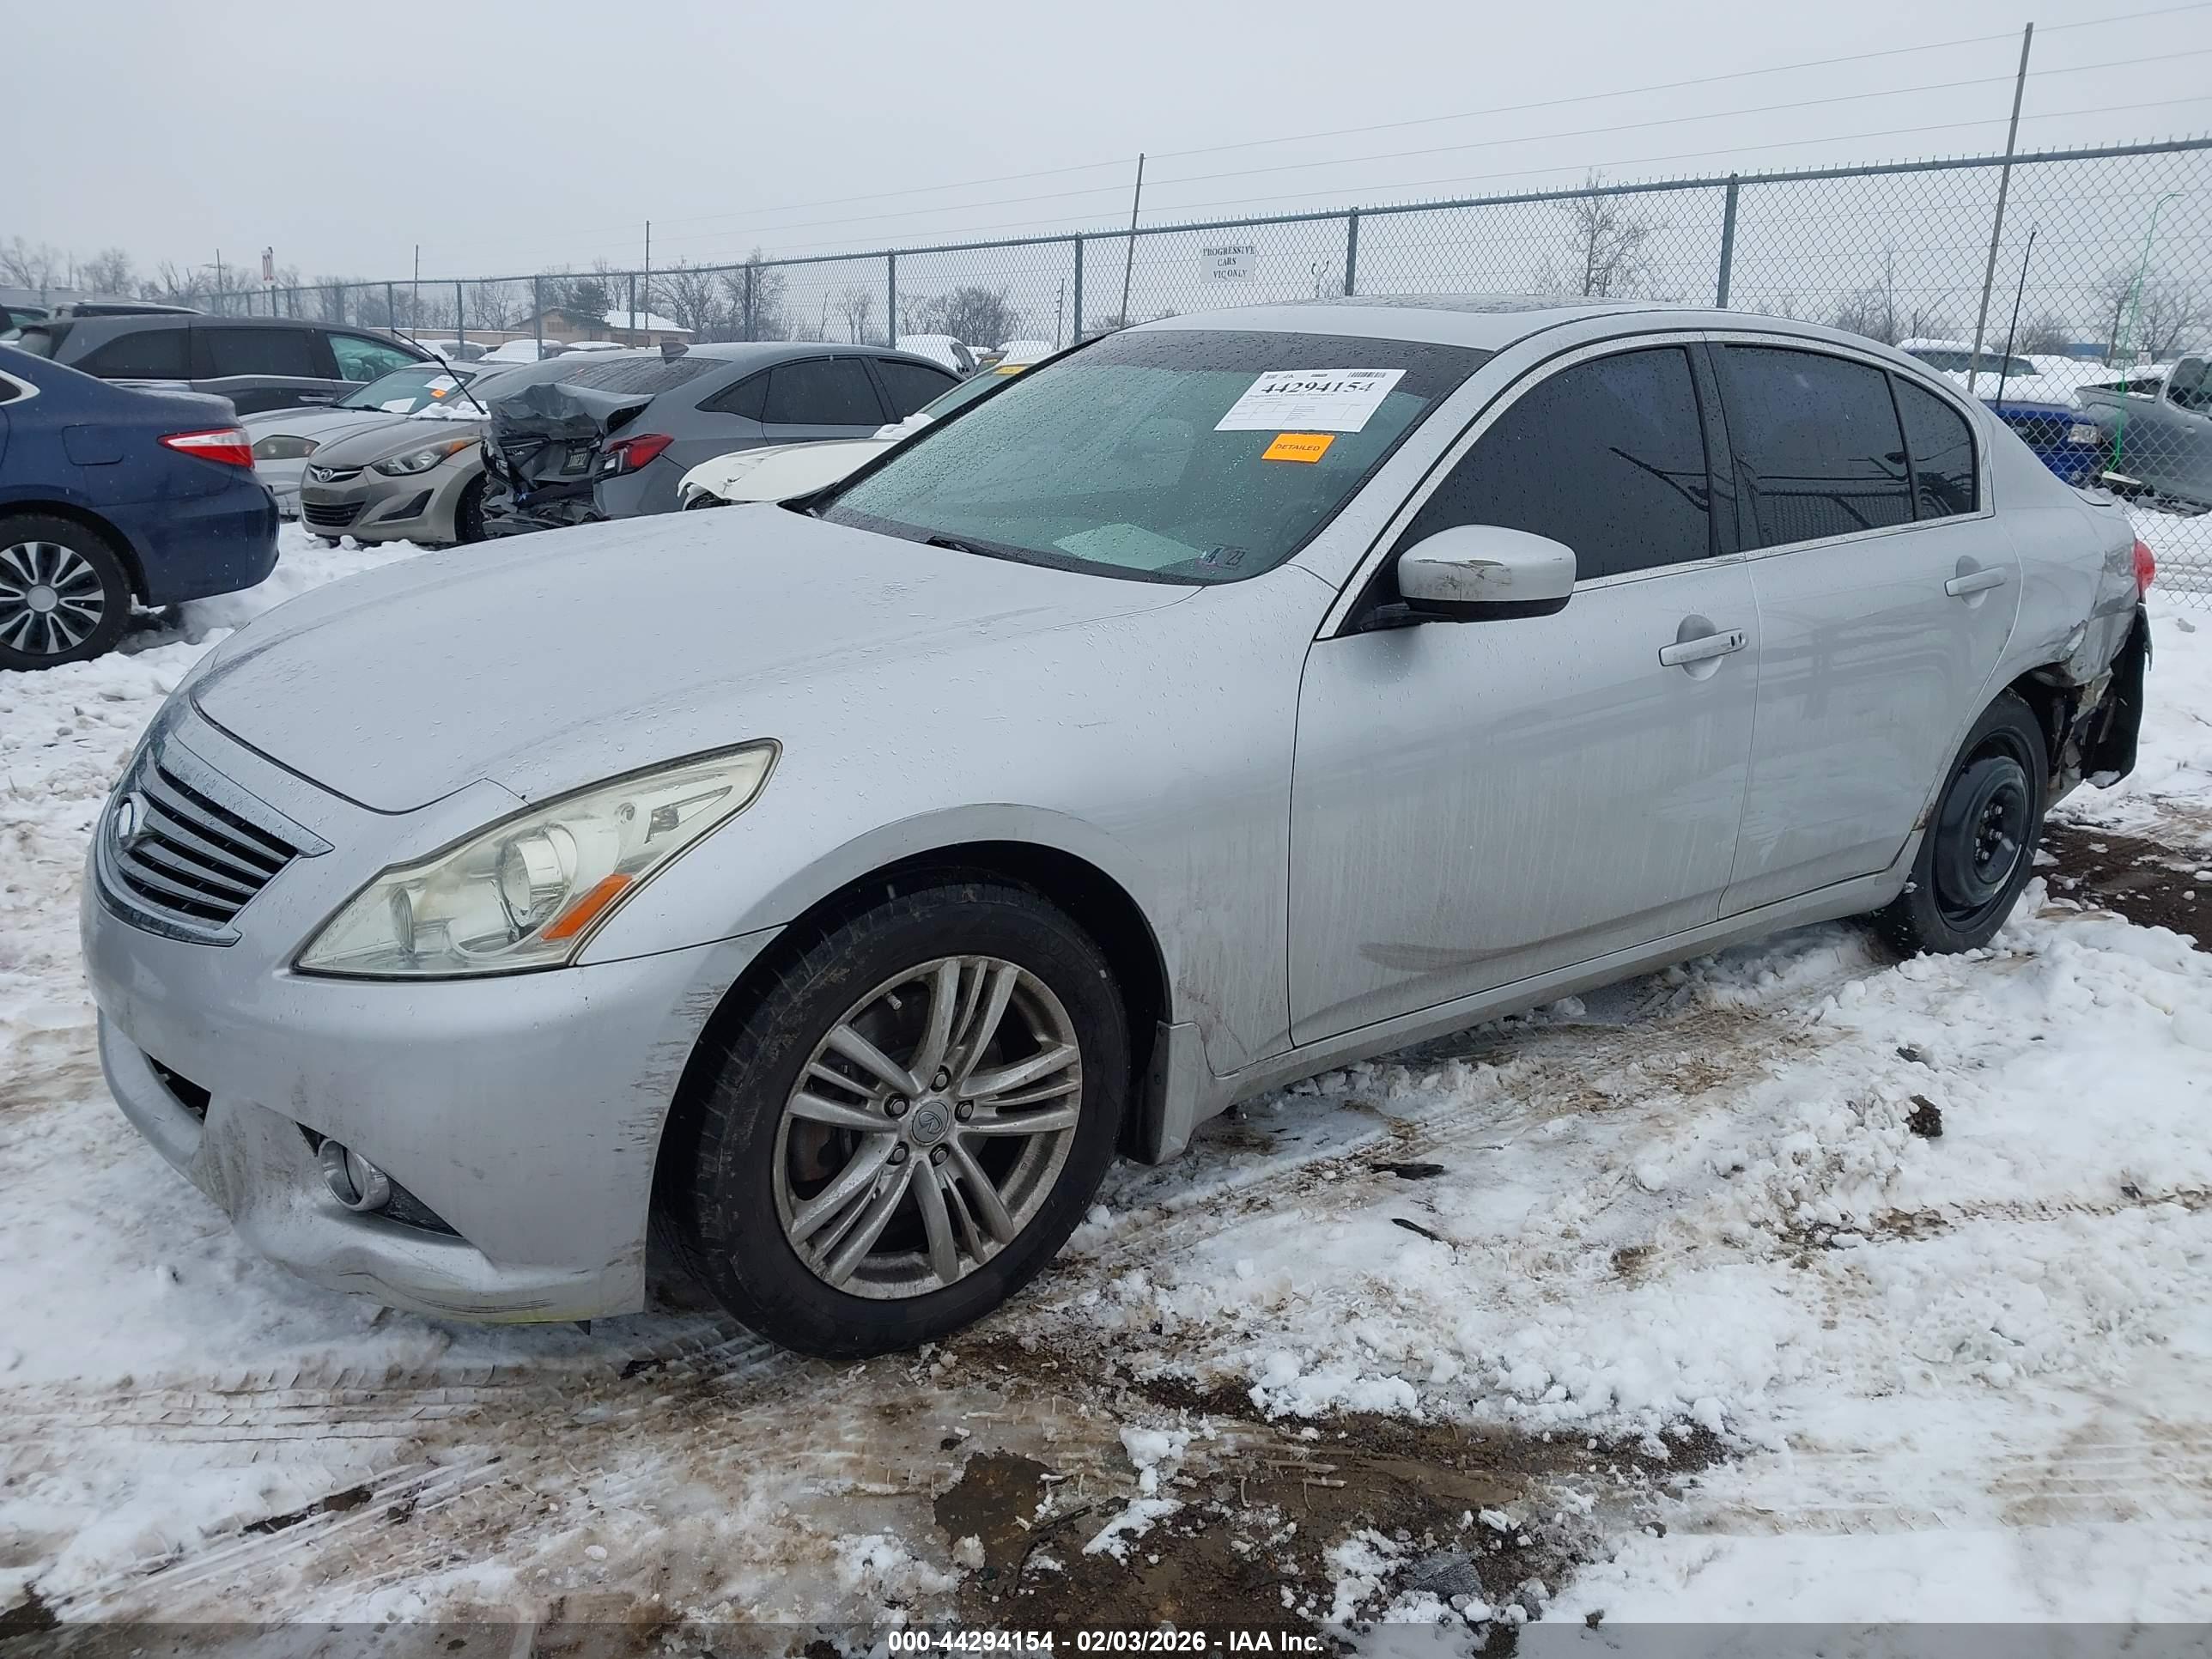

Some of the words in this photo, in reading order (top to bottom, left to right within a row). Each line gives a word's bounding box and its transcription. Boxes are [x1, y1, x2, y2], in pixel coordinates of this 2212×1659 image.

[1203, 246, 1255, 256] PROGRESSIVE
[1217, 257, 1237, 266] CARS
[1227, 269, 1248, 277] ONLY
[1261, 381, 1375, 394] 44294154
[1275, 443, 1321, 452] DETAILED
